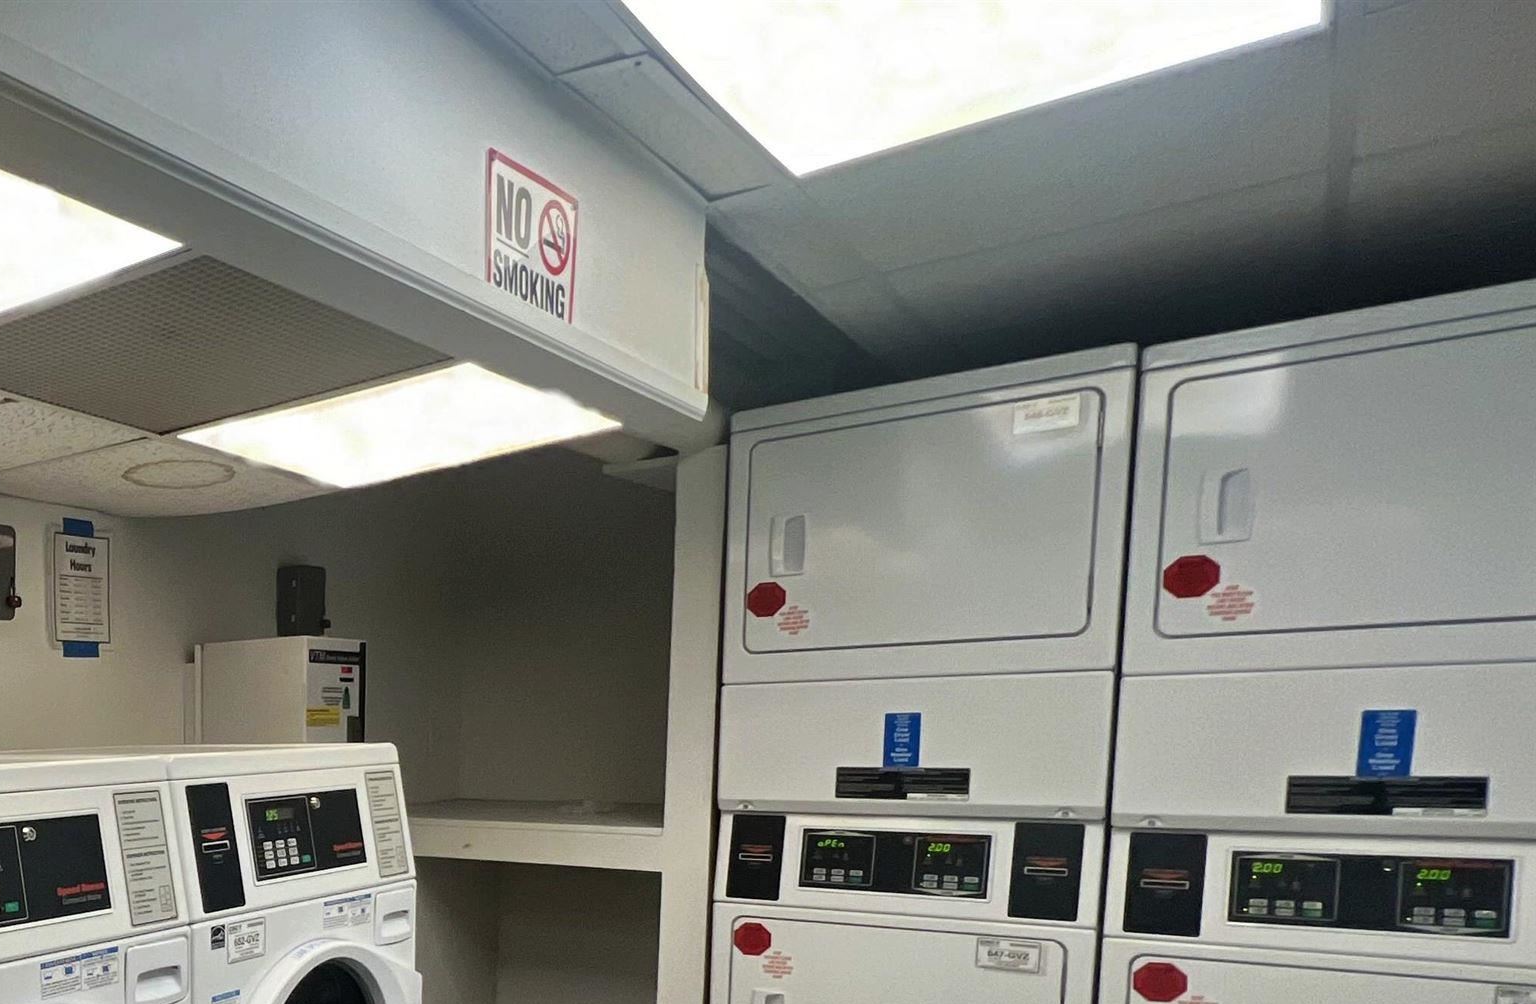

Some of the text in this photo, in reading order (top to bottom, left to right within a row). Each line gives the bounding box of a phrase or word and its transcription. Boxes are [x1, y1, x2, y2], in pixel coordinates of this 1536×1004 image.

[496, 173, 532, 250] NO
[493, 249, 565, 320] SMOKING
[65, 541, 96, 557] Laundry
[69, 559, 92, 572] Hours
